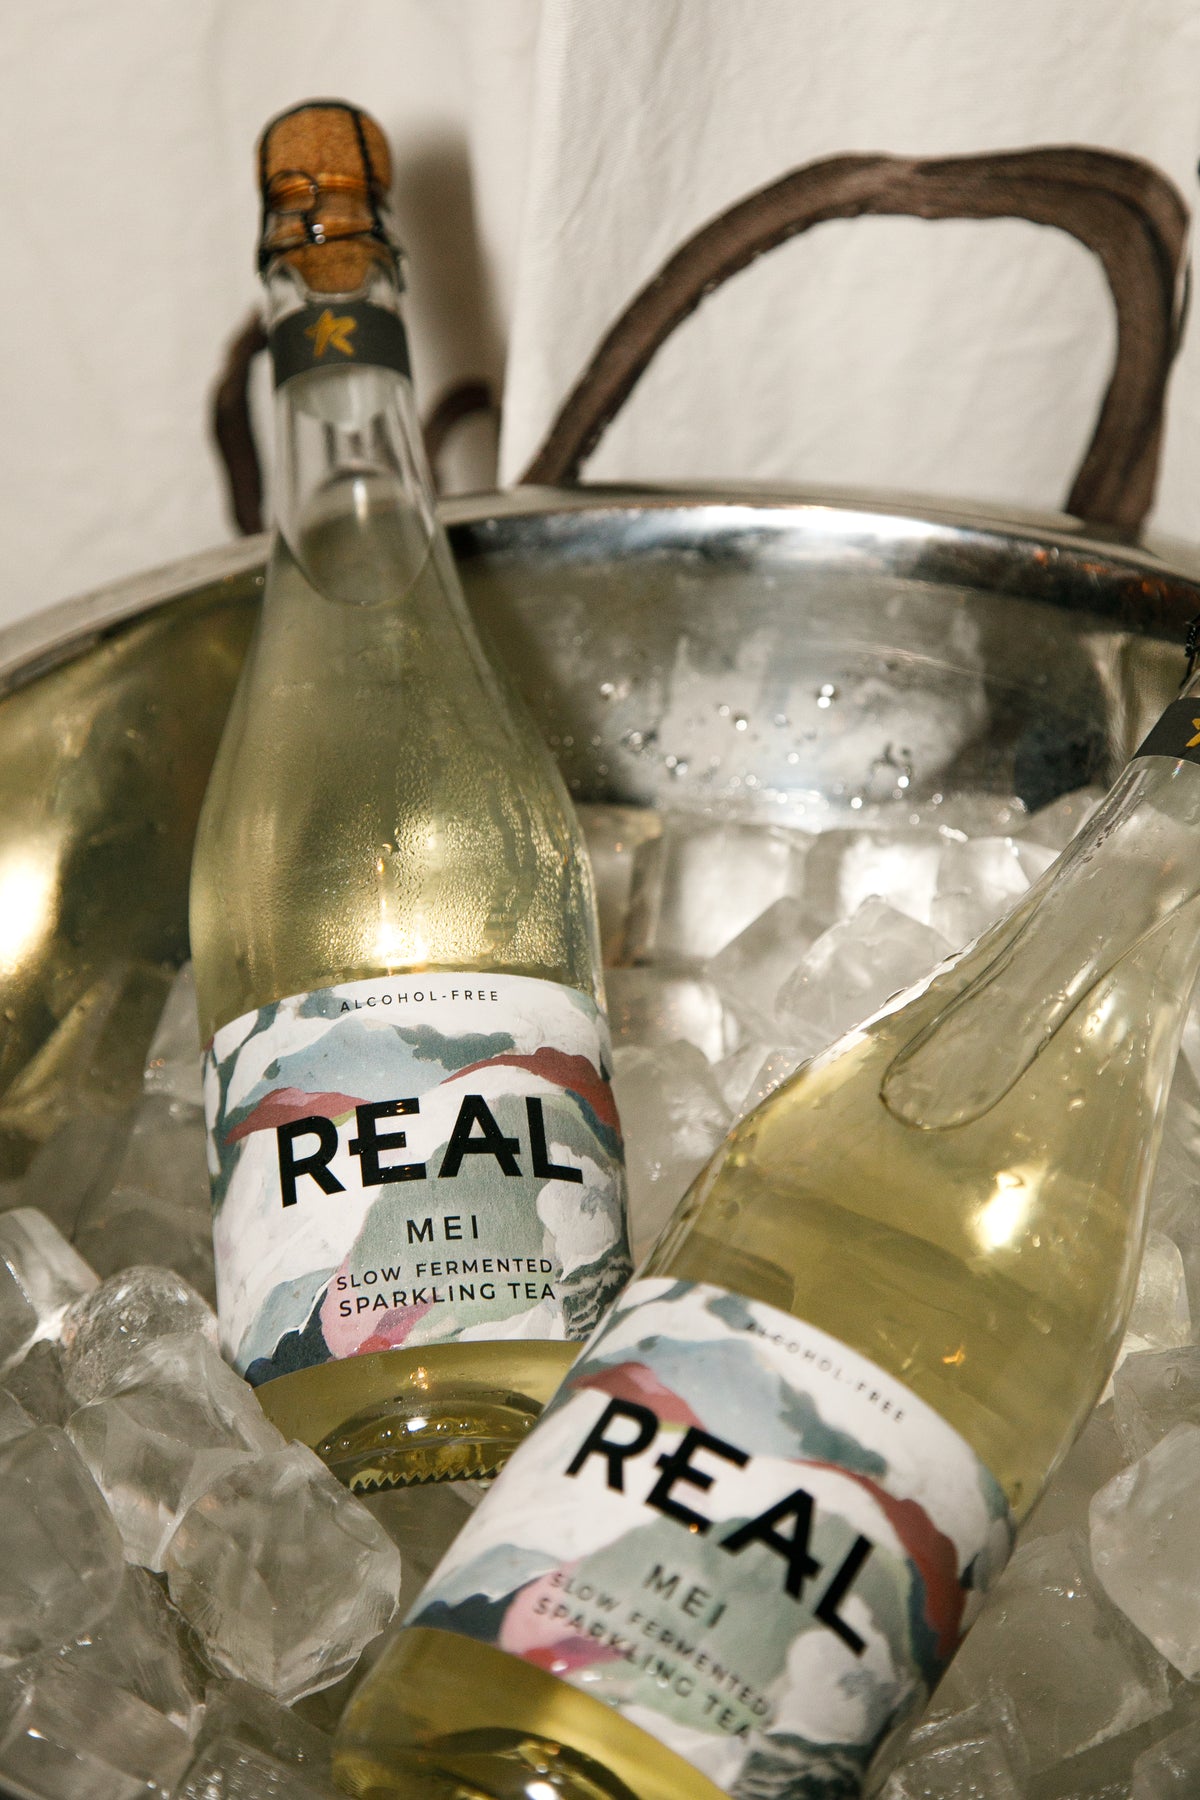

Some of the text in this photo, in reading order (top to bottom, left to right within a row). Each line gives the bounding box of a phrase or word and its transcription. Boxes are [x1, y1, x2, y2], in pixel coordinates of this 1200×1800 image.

[340, 990, 499, 1013] ALCOHOL-FREE
[276, 1094, 584, 1208] REAL
[407, 1215, 478, 1244] MEI
[336, 1258, 553, 1291] SLOW FERMENTED
[339, 1282, 556, 1317] SPARKLING TEA
[565, 1395, 874, 1659] REAL
[644, 1564, 728, 1630] MEI
[532, 1598, 751, 1740] SPARKLING TEA
[549, 1571, 770, 1717] SLOW FERMENTED
